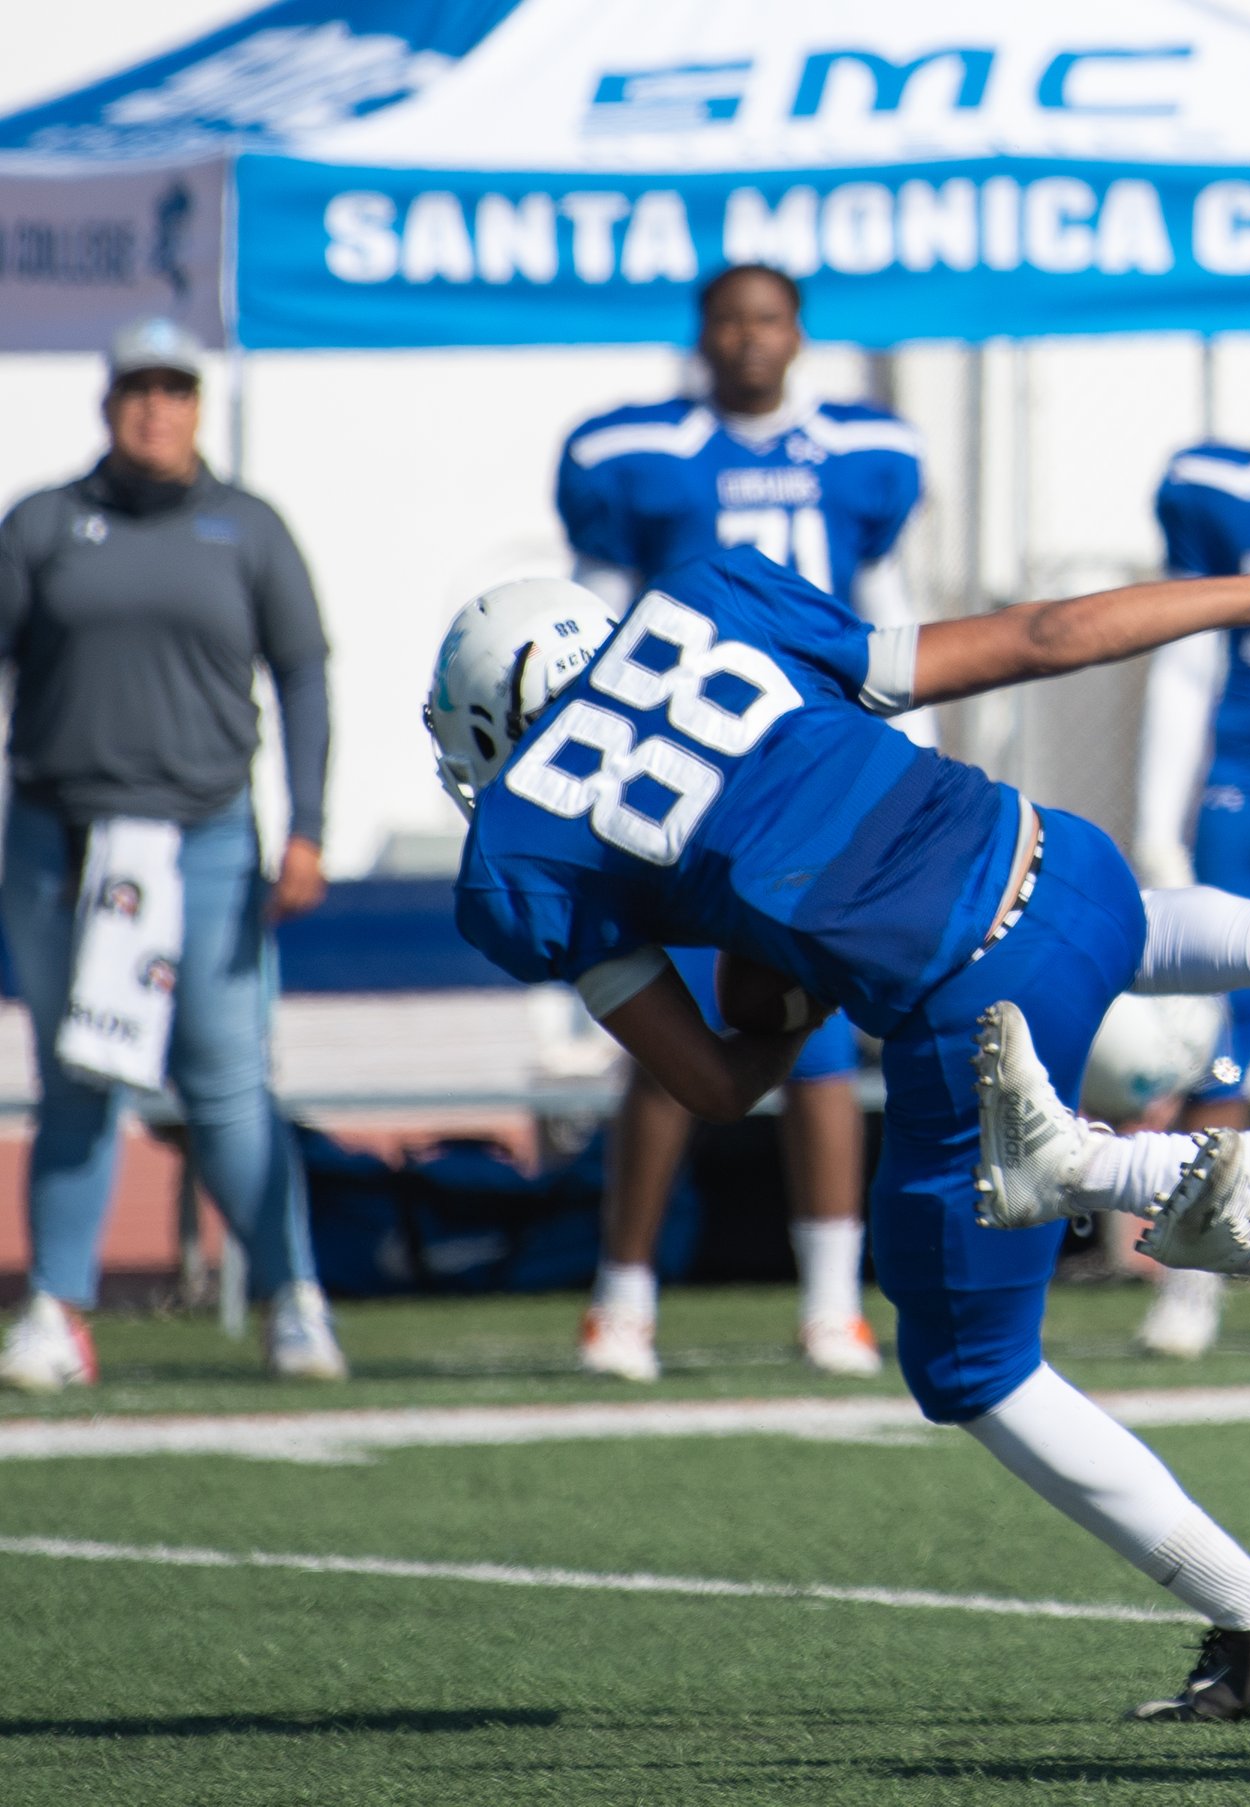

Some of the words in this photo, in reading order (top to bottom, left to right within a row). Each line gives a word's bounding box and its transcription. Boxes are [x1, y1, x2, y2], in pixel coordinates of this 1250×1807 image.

[323, 189, 700, 285] SANTA
[722, 174, 1176, 278] MONICA
[554, 619, 580, 638] 88
[556, 646, 600, 672] sch
[504, 589, 805, 867] 88
[1001, 1089, 1021, 1169] adidas
